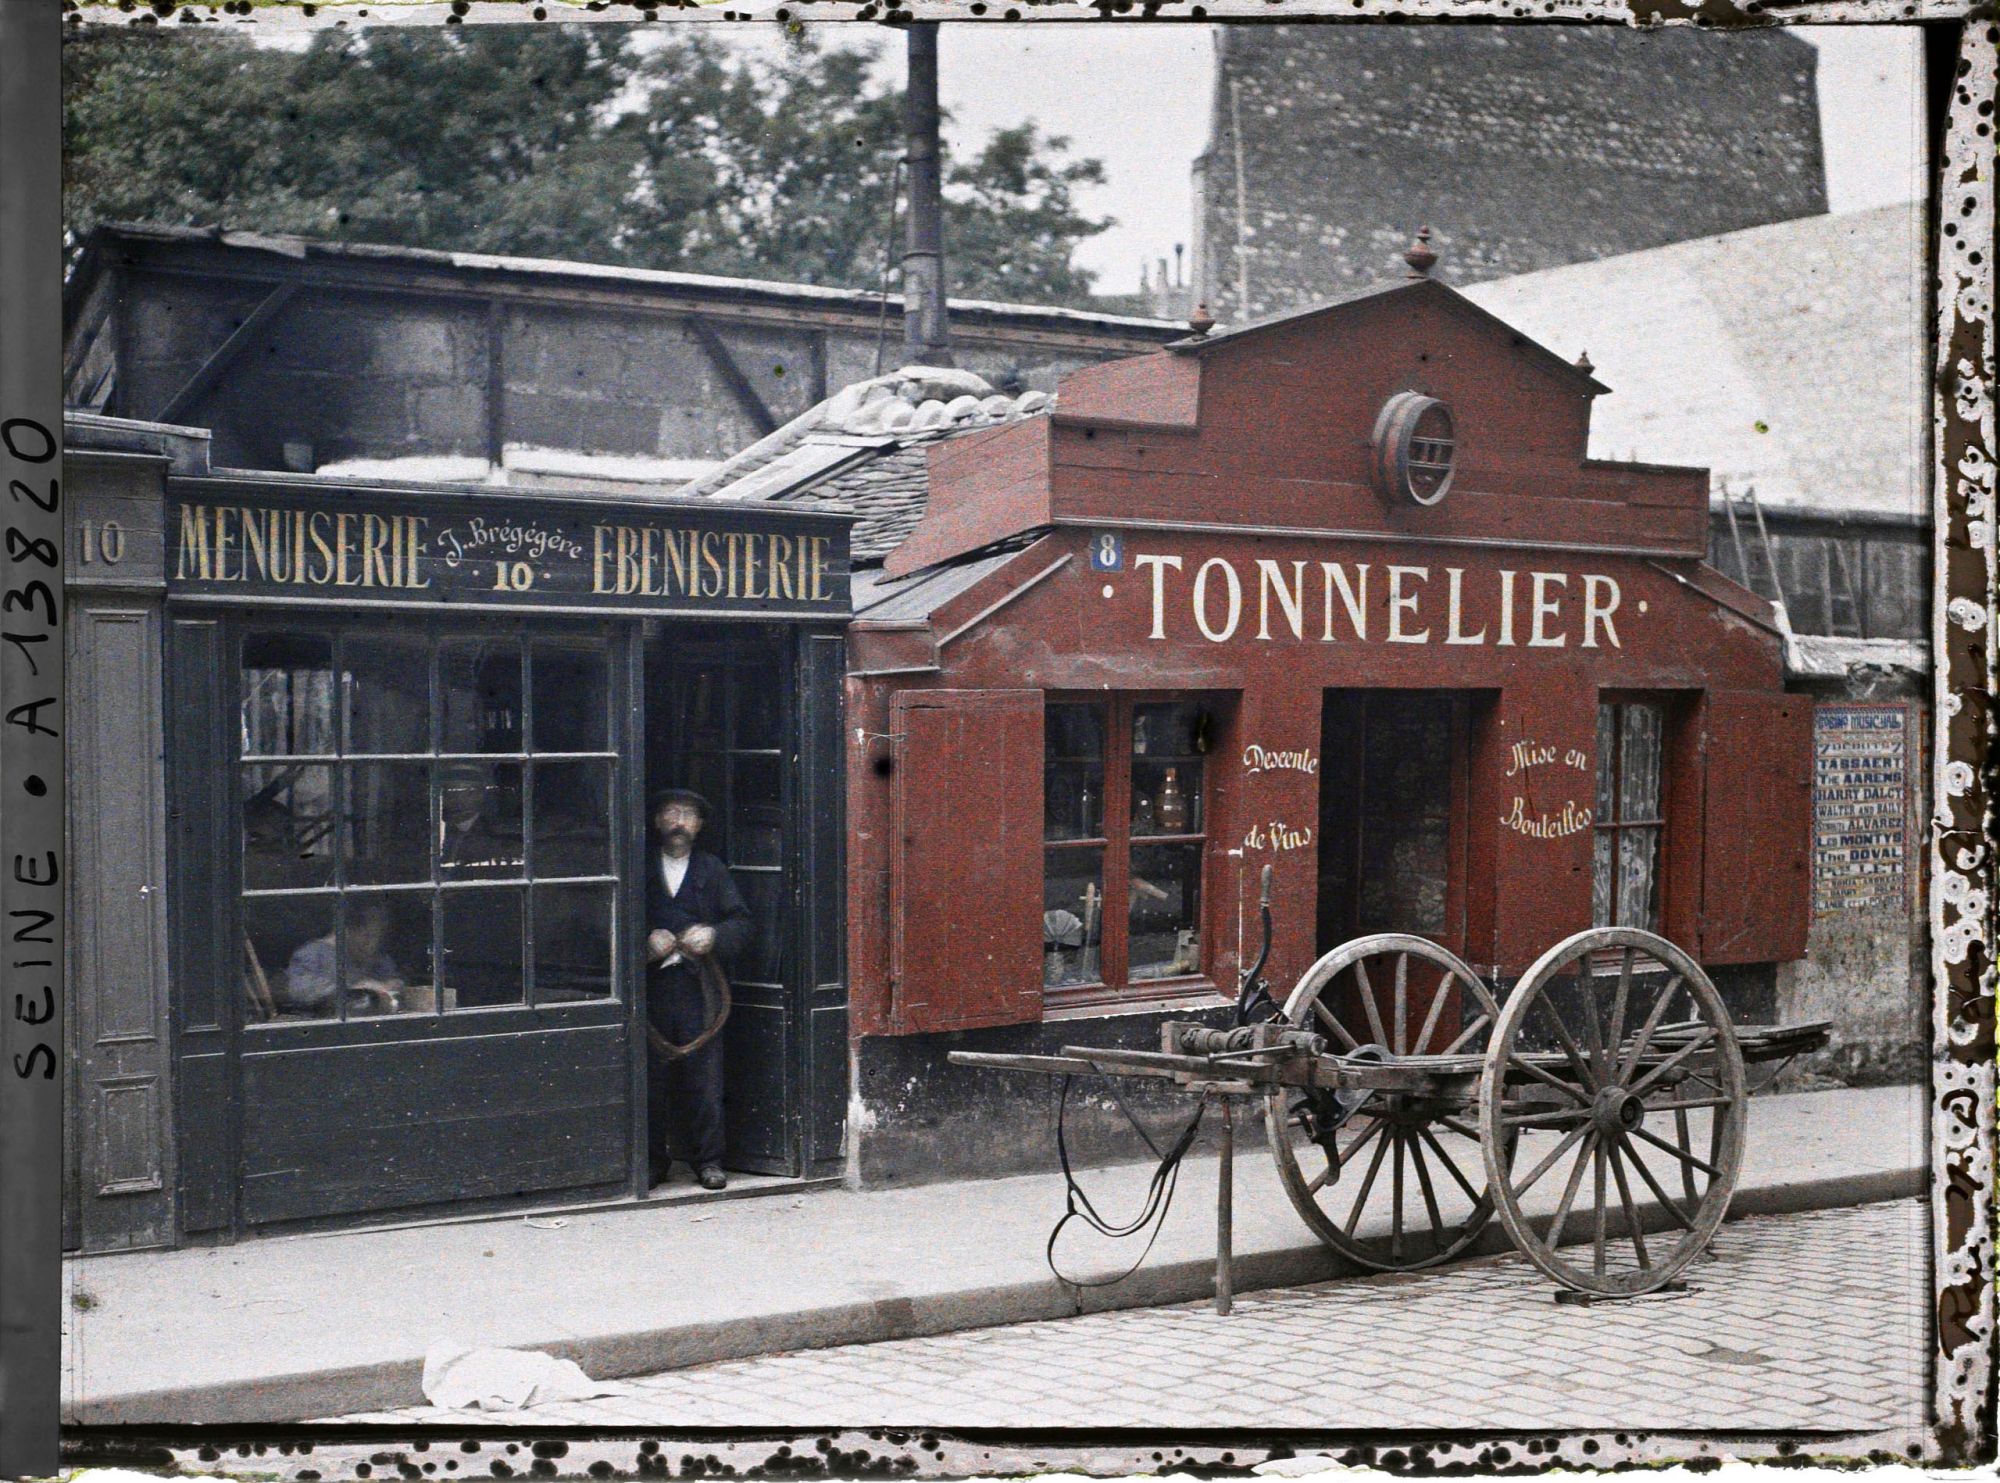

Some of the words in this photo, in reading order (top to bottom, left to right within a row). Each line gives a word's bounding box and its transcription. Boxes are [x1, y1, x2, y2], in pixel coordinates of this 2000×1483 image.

[79, 520, 126, 565] 10
[174, 503, 432, 588] MENUISERIE
[591, 518, 834, 600] ÉBÉNISTERIE
[1099, 533, 1117, 567] 8
[492, 560, 535, 592] 10
[1133, 553, 1623, 649] TONNELIER
[1243, 744, 1318, 777] Descente
[1506, 740, 1557, 777] Mise
[1565, 749, 1587, 771] en
[1817, 788, 1860, 801] HARRY
[1500, 796, 1593, 839] Bouteilles
[1848, 818, 1902, 831] ALVAREZ
[1244, 824, 1266, 850] de
[1268, 820, 1312, 853] Vins
